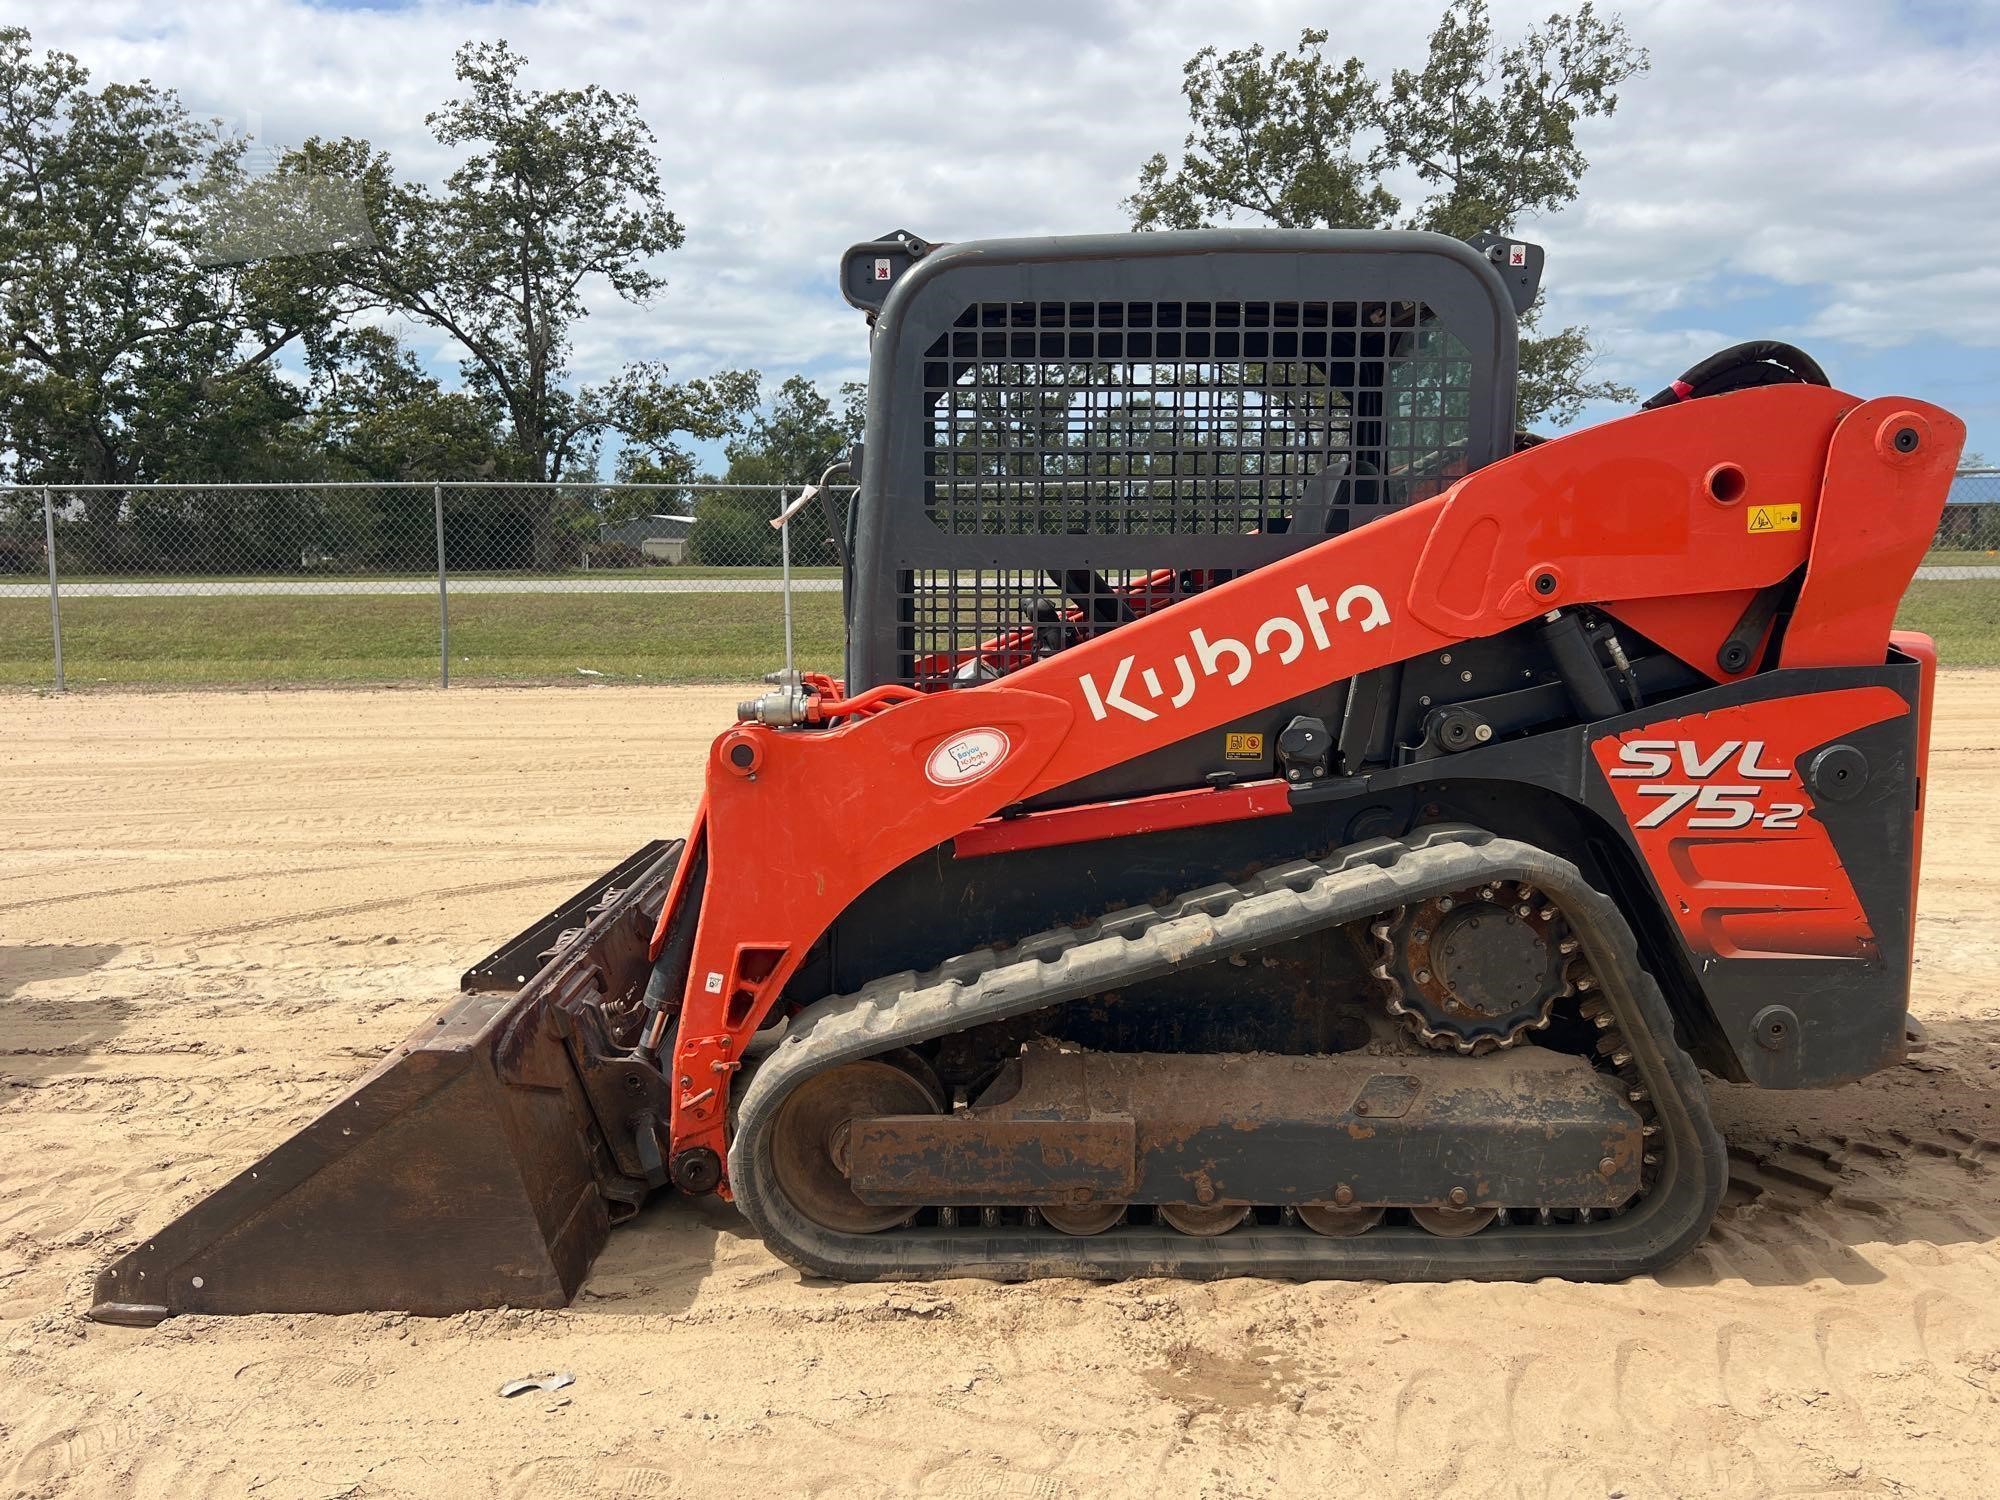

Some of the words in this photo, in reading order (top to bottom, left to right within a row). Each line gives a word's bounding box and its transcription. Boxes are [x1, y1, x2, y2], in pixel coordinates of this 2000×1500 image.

[1079, 584, 1391, 722] Kubota
[957, 746, 980, 759] Bayou
[960, 751, 989, 766] Kubota
[1609, 740, 1792, 779] SVL
[1633, 784, 1805, 829] 75-2
